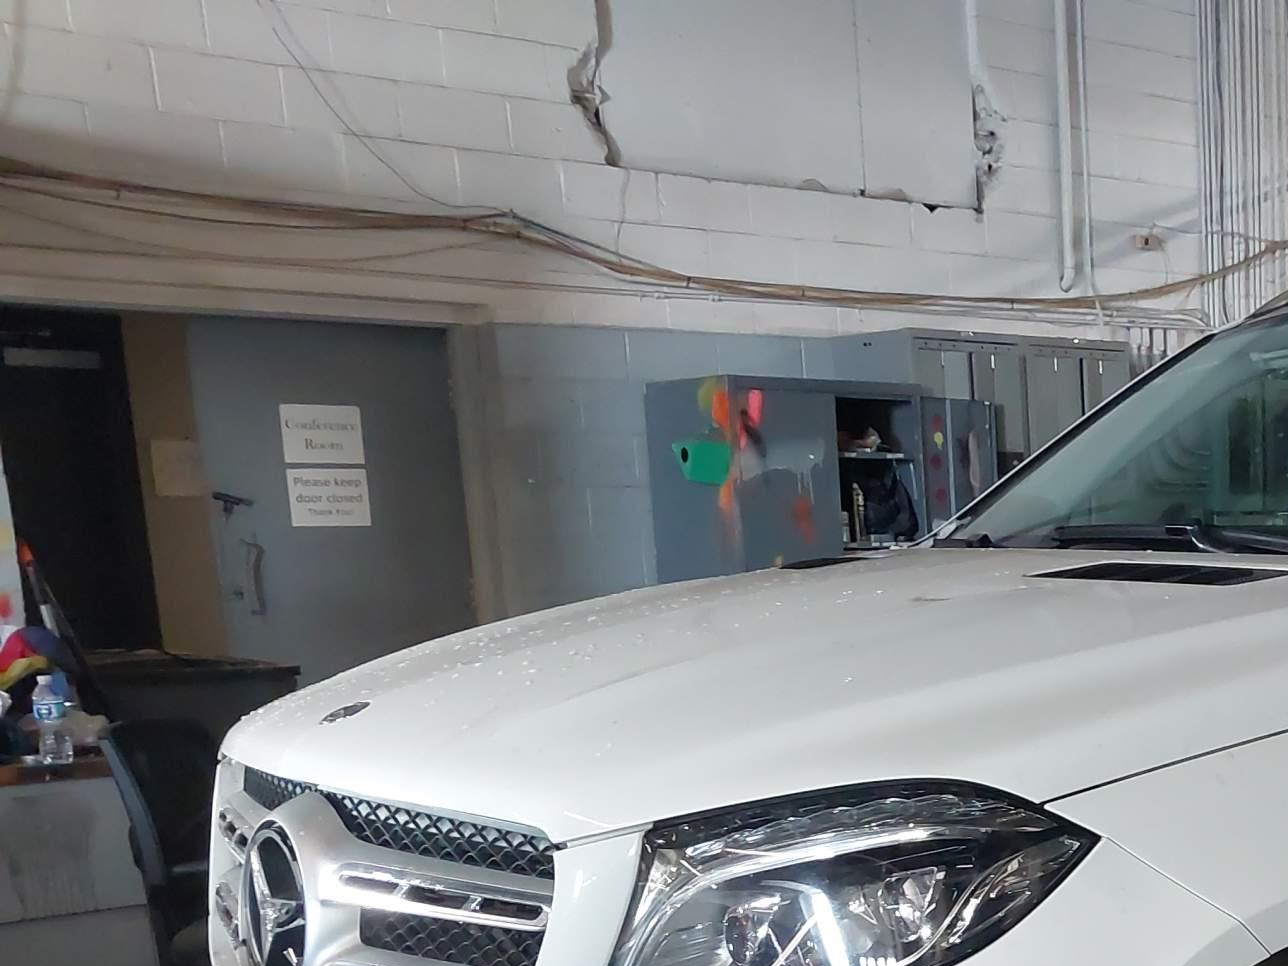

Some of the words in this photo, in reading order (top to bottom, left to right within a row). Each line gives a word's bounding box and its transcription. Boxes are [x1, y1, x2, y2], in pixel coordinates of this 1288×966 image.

[304, 438, 344, 451] Room
[293, 476, 331, 488] Please
[334, 477, 362, 489] keep
[296, 493, 323, 504] door
[326, 493, 363, 504] closed
